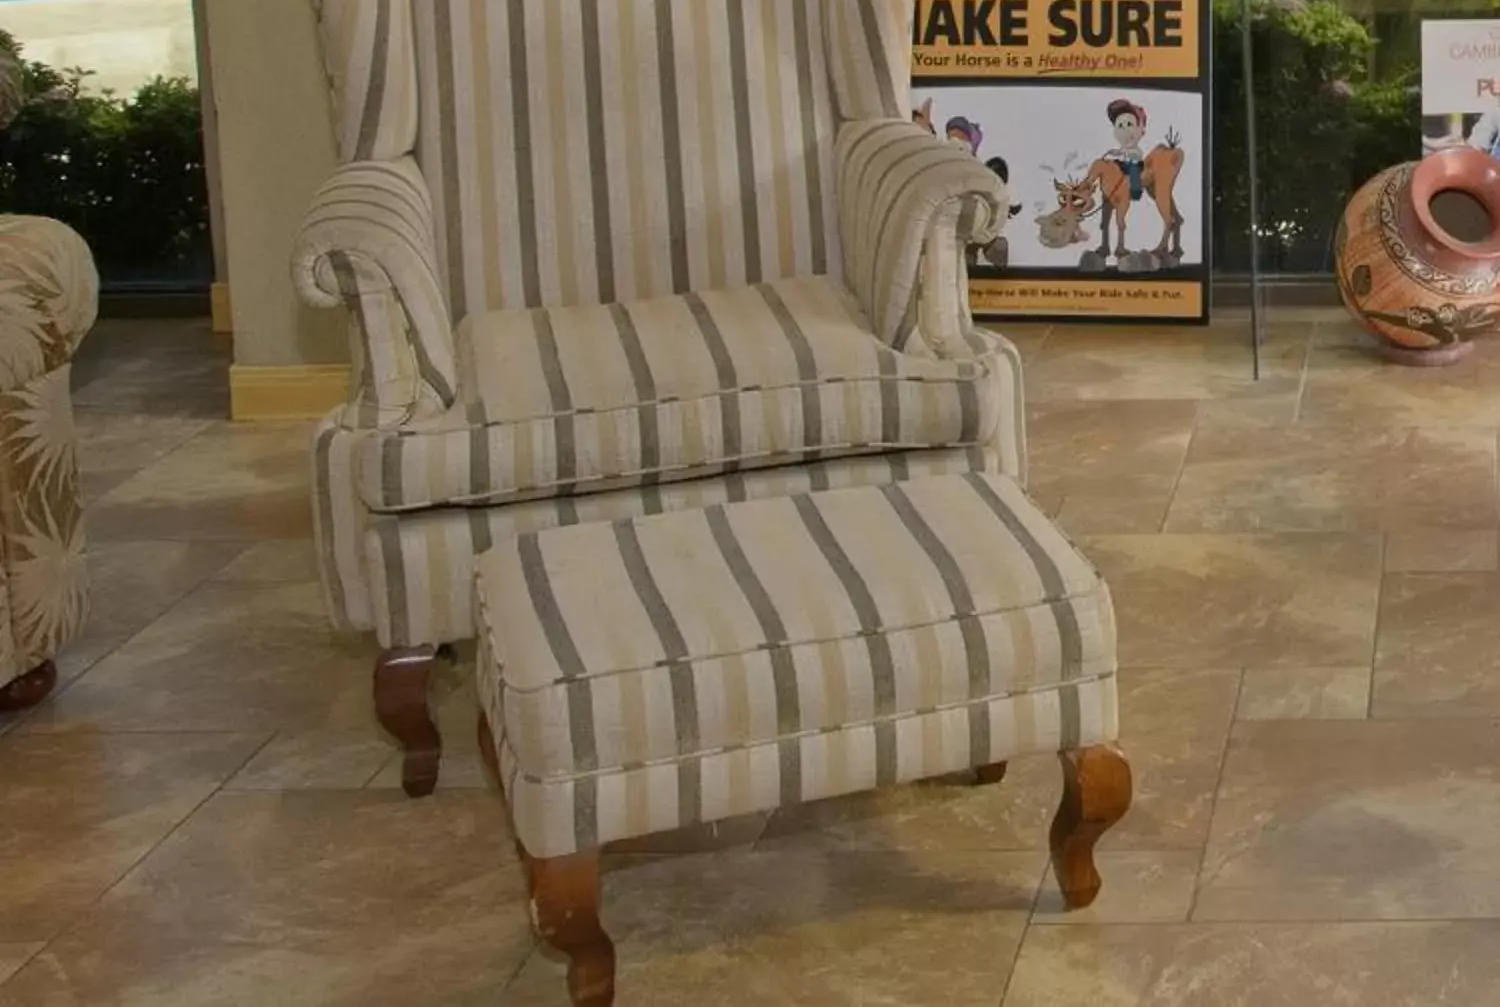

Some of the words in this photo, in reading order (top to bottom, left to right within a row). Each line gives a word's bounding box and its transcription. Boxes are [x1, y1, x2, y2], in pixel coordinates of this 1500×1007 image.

[914, 52, 951, 68] Your
[955, 52, 1001, 68] Horse
[1006, 52, 1019, 68] is
[1023, 56, 1033, 68] a
[1037, 53, 1101, 71] Healthy
[1104, 53, 1144, 70] One!
